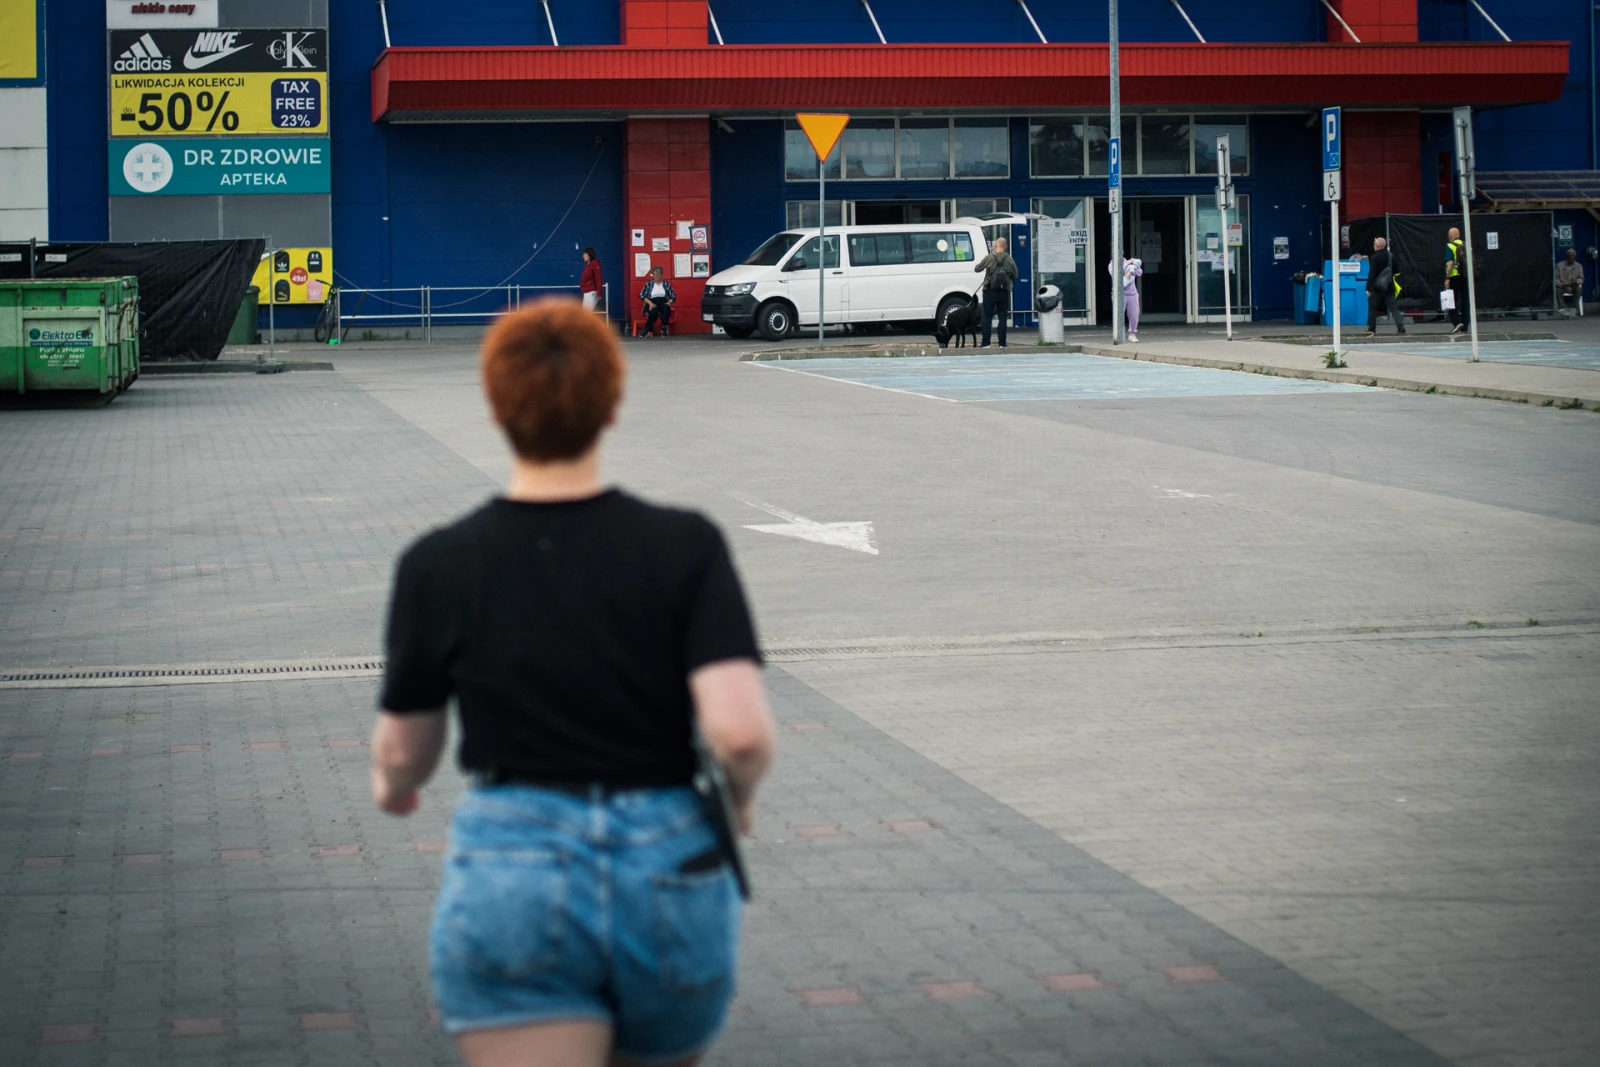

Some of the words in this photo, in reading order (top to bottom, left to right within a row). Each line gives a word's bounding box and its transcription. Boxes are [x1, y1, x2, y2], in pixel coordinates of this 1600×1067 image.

[193, 32, 239, 52] NIKE
[114, 56, 172, 71] adidas
[114, 79, 185, 88] LIKWIDACJA
[188, 78, 244, 87] KOLEKCJI
[281, 81, 310, 93] TAX
[121, 91, 239, 131] -50%
[275, 98, 315, 110] FREE
[280, 114, 311, 127] 23%
[1326, 113, 1336, 152] P
[184, 149, 215, 166] DR
[220, 148, 321, 165] ZDROWIE
[1111, 142, 1117, 173] P
[220, 173, 287, 185] APTEKA
